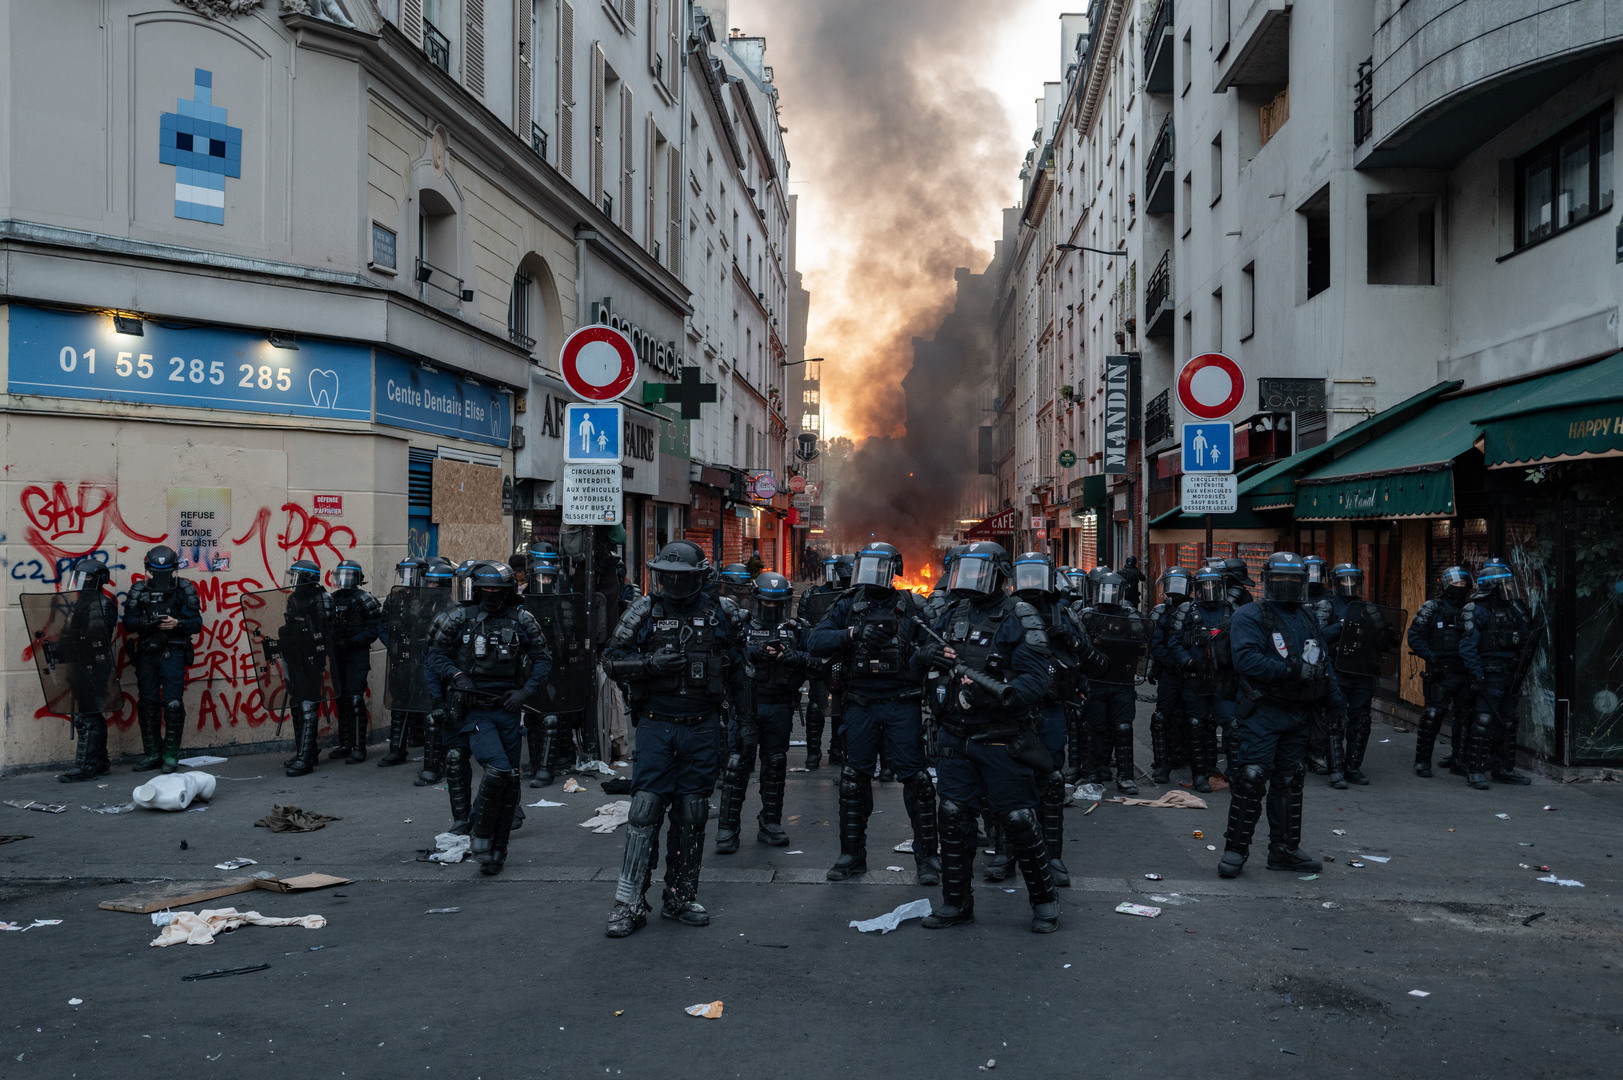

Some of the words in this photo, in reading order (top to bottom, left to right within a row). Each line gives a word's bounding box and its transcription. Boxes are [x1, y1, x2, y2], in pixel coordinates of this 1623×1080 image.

[59, 346, 96, 374] 01
[115, 351, 154, 379] 55
[168, 356, 225, 385] 285
[238, 363, 292, 392] 285
[1268, 382, 1319, 392] PIZZA
[387, 379, 421, 407] Centre
[424, 389, 462, 416] Dentaire
[465, 400, 485, 422] Elise
[1106, 363, 1128, 467] MANDIN
[1568, 417, 1611, 439] HAPPY
[582, 485, 620, 493] VÉHICULES
[180, 511, 215, 519] REFUSE
[180, 520, 193, 528] CE
[180, 529, 212, 537] MONDE
